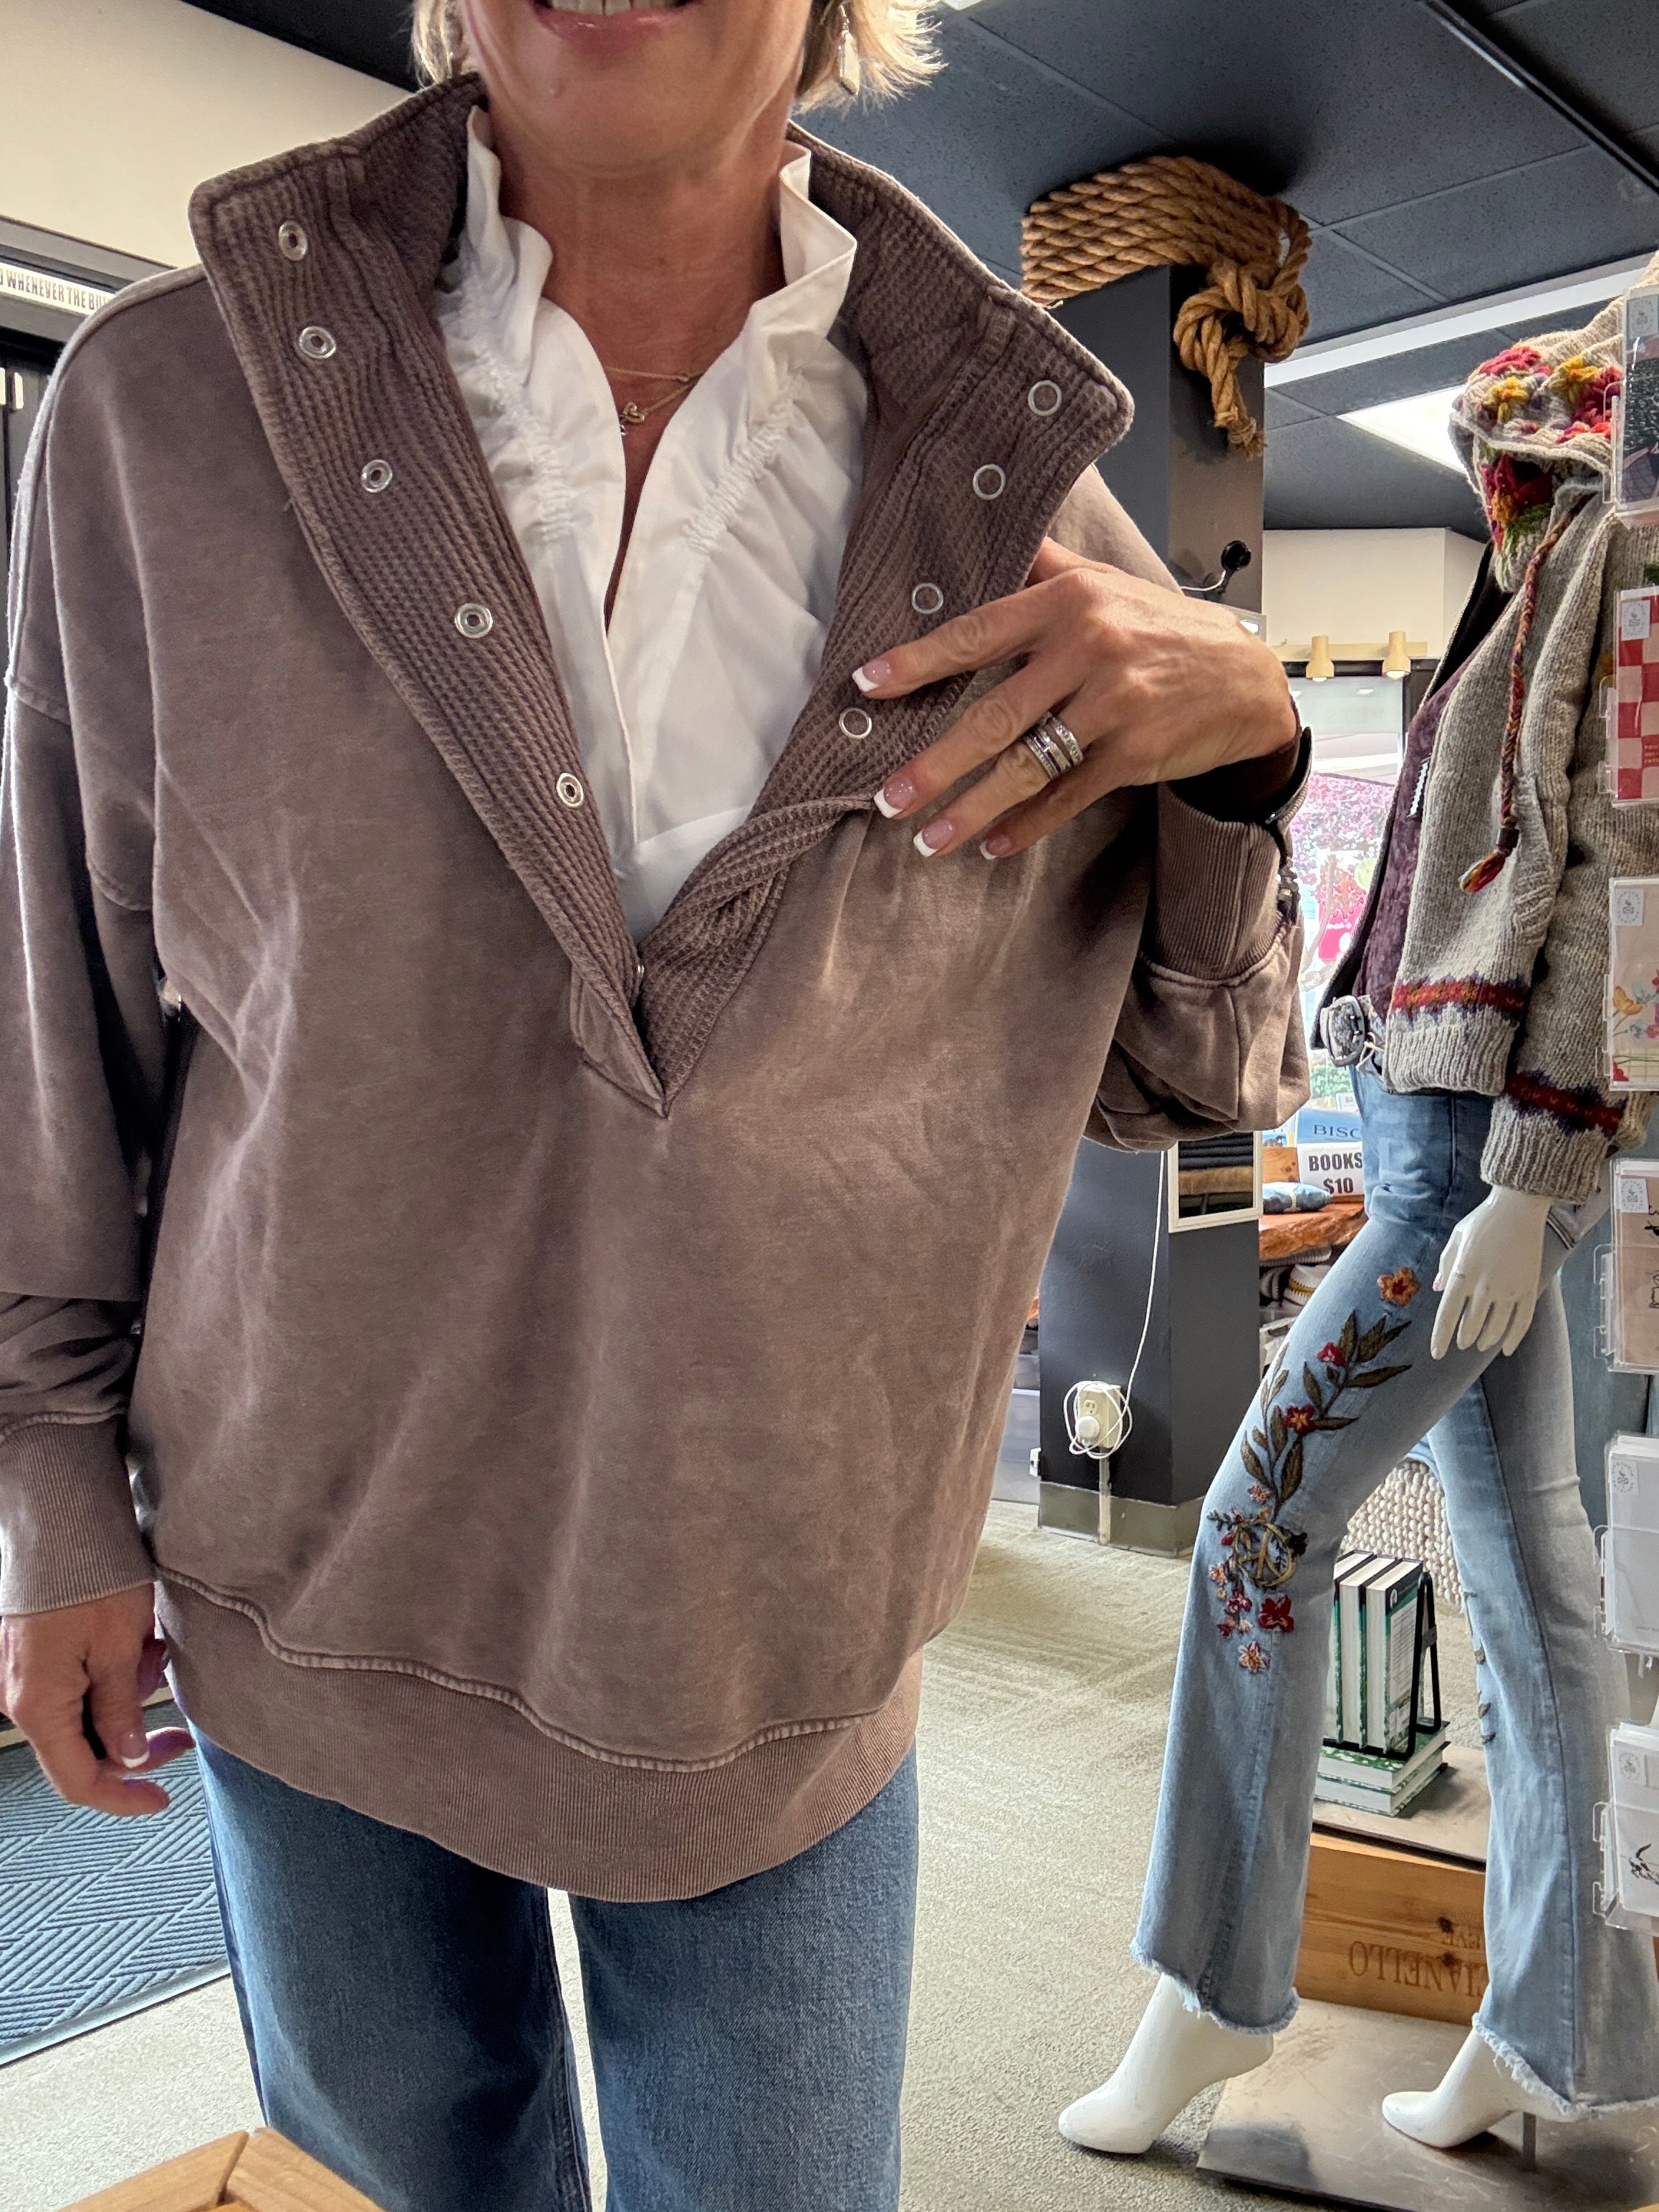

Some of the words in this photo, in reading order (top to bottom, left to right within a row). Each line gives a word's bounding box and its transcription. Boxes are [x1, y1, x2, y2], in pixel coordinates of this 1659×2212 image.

[6, 269, 64, 302] WHENEVER
[67, 287, 86, 309] THE
[1308, 1152, 1362, 1172] BOOKS
[1323, 1177, 1354, 1195] $10
